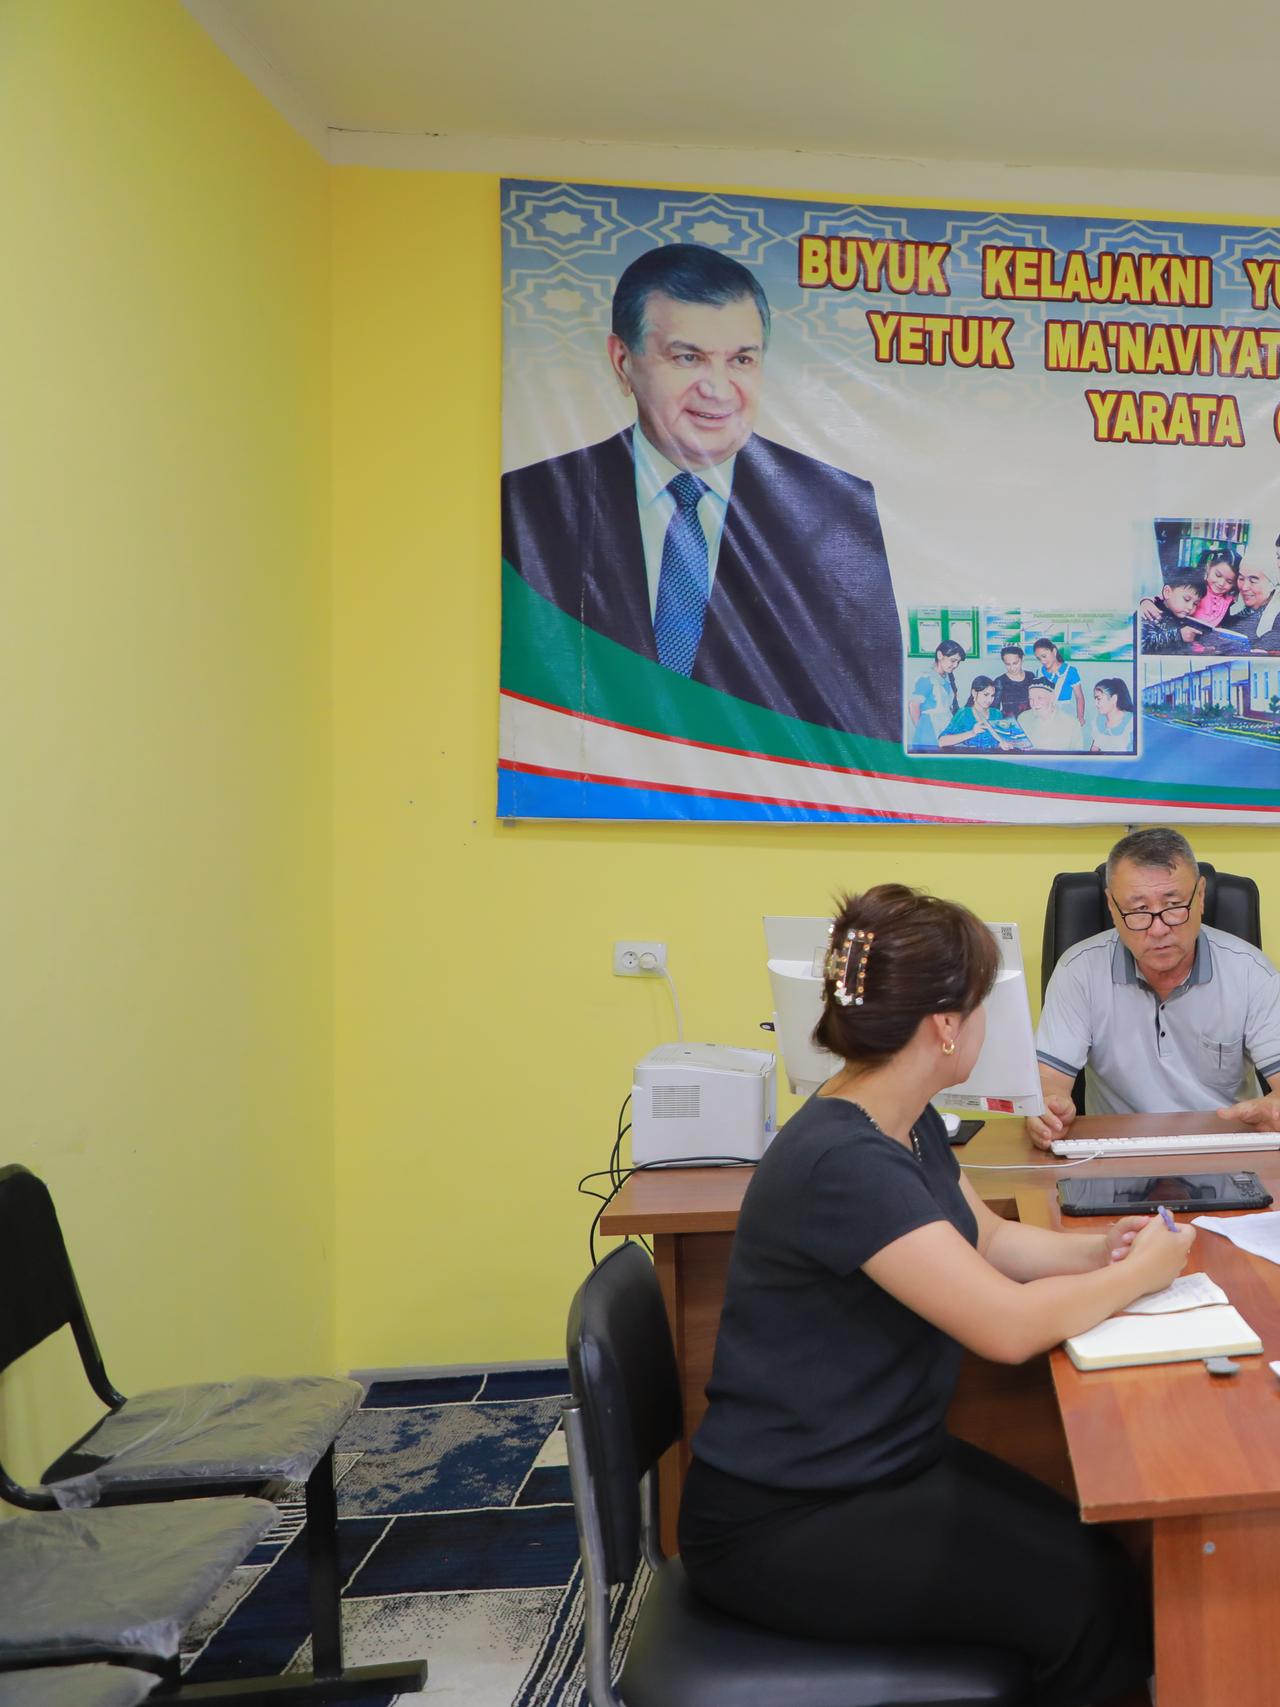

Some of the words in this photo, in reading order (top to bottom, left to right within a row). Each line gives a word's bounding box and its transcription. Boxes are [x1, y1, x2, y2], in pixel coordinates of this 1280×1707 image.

[799, 235, 951, 296] BUYUK
[981, 245, 1213, 307] KELAJAKNI
[866, 310, 1015, 369] YETUK
[1084, 390, 1246, 447] YARATA
